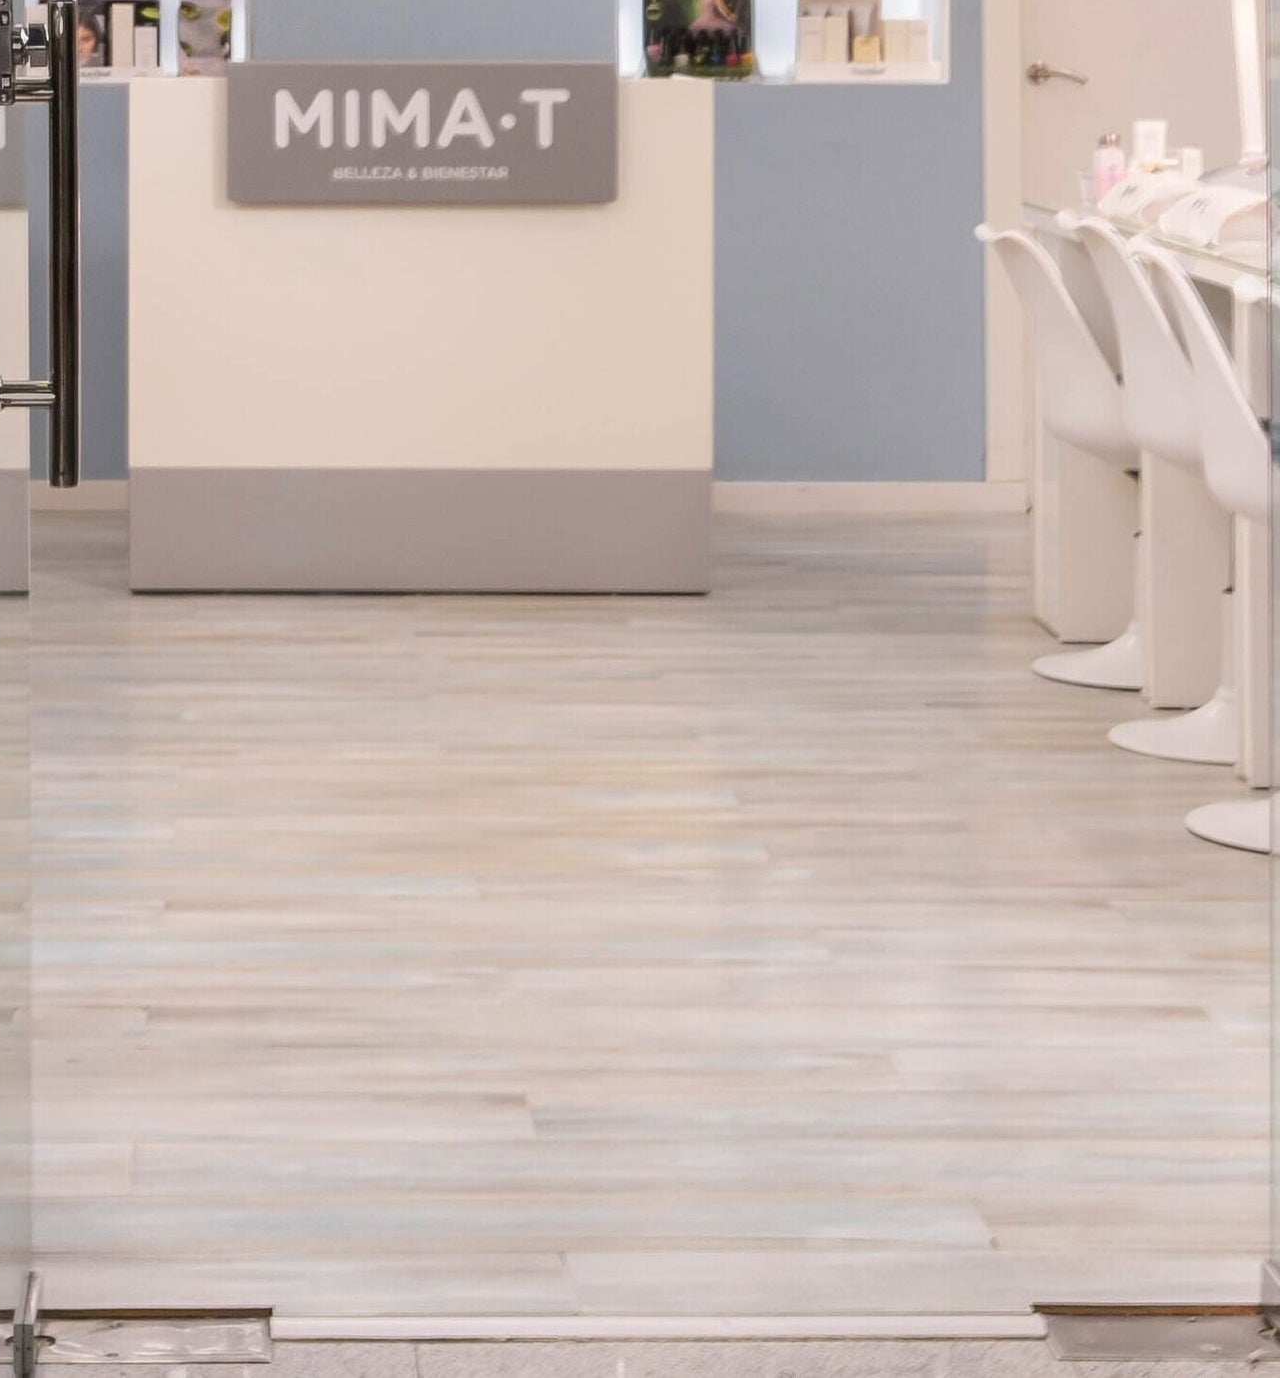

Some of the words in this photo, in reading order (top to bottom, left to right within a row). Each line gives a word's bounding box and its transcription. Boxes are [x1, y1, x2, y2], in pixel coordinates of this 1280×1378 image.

[274, 88, 571, 150] MIMA·T
[332, 165, 403, 181] BELLEZA
[421, 165, 510, 181] BIENESTAR
